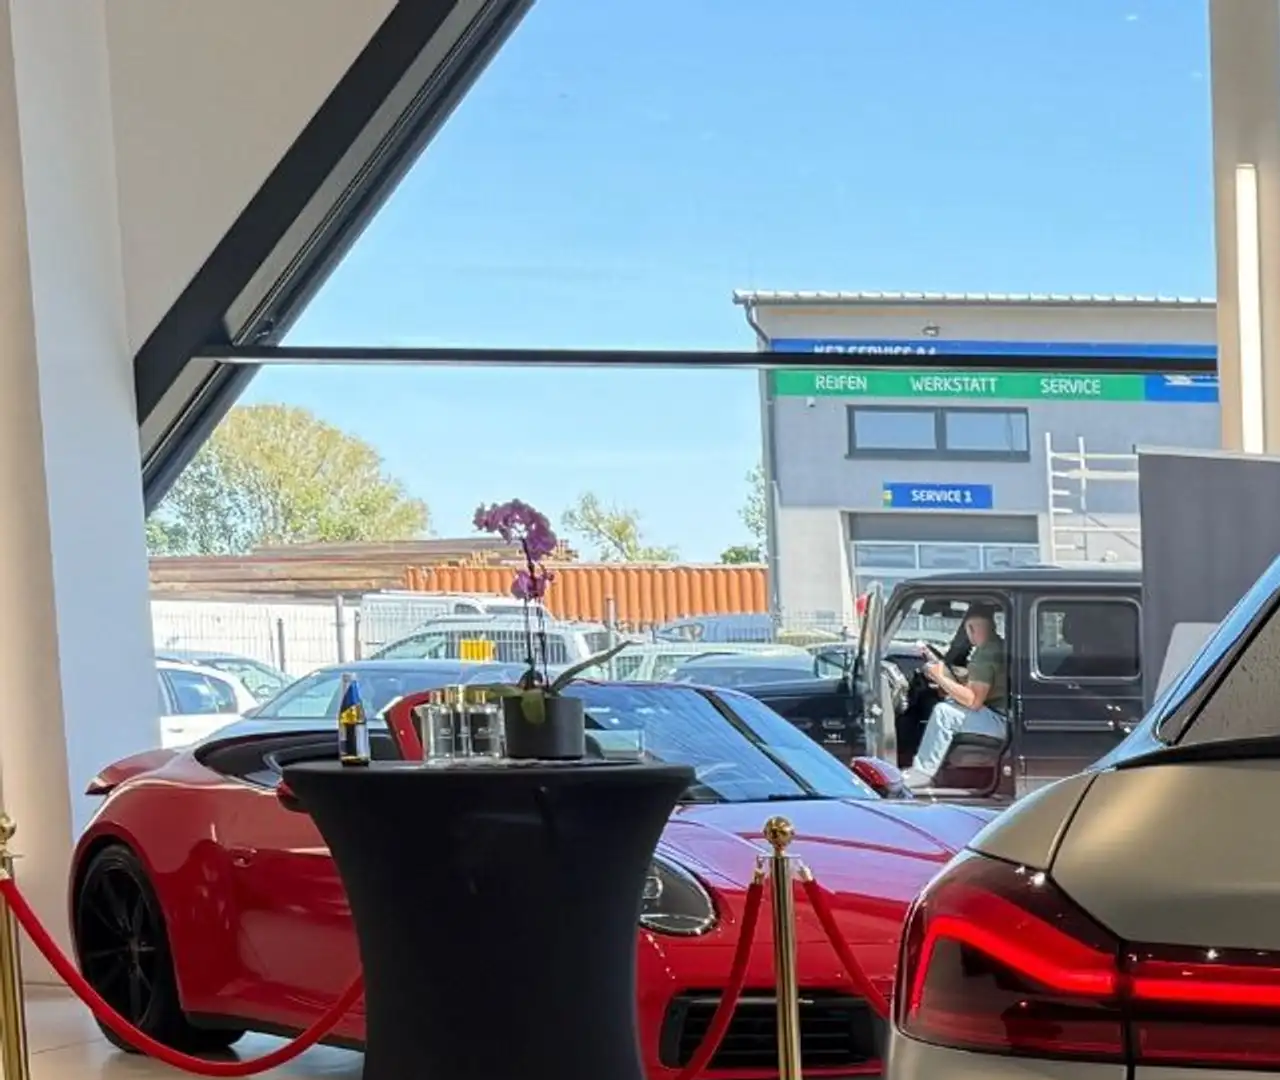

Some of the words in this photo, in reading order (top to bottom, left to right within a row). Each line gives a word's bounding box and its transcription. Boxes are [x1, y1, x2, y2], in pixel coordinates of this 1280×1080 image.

[815, 375, 868, 391] REIFEN
[908, 376, 998, 394] WERKSTATT
[1039, 378, 1101, 395] SERVICE
[911, 489, 961, 503] SERVICE
[963, 490, 973, 504] 1
